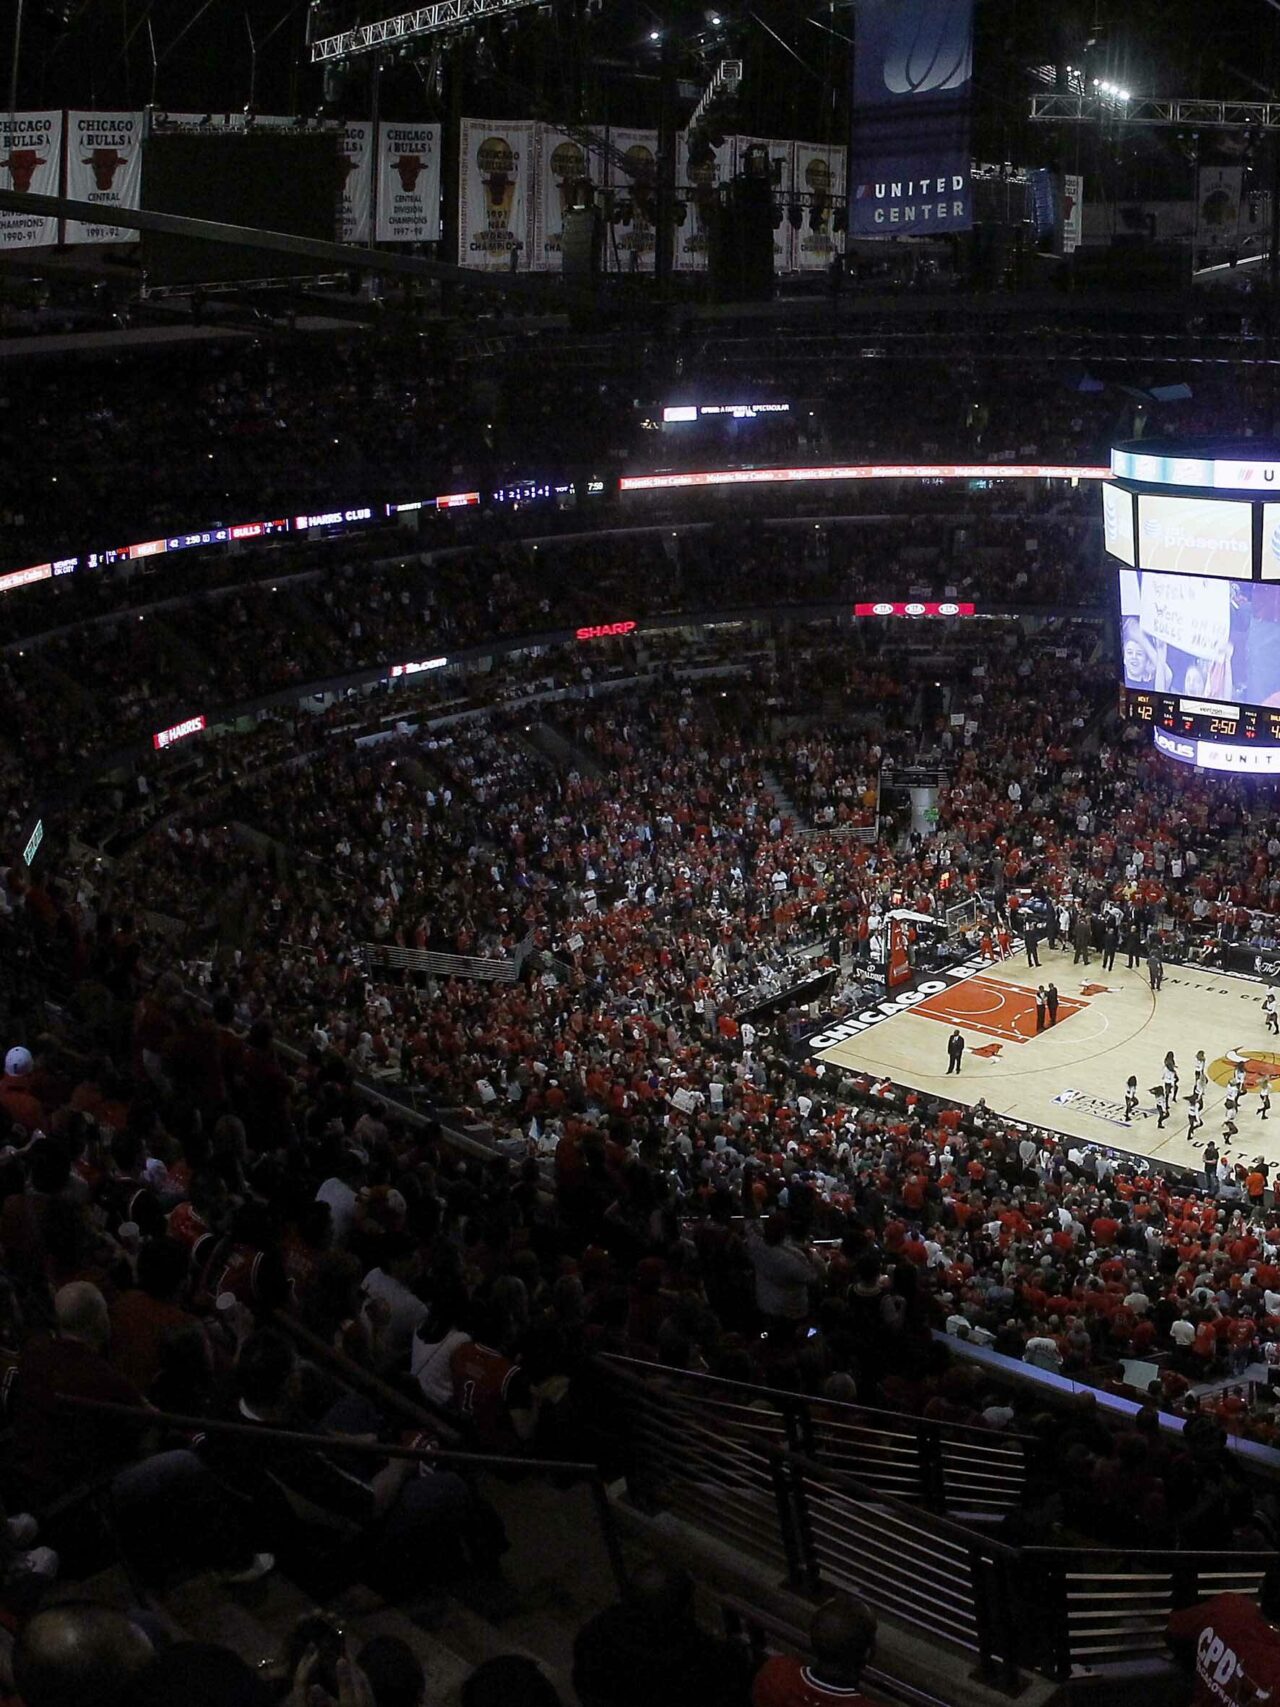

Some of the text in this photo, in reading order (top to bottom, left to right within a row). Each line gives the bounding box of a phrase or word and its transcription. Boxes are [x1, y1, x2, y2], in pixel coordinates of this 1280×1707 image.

[78, 120, 133, 132] CHICAGO
[3, 135, 44, 148] BULLS
[87, 135, 127, 146] BULLS
[387, 130, 433, 141] CHICAGO
[394, 143, 426, 153] BULLS
[875, 175, 964, 199] UNITED
[88, 193, 120, 201] CENTRAL
[874, 201, 964, 224] CENTER
[389, 217, 427, 225] CHAMPIONS
[4, 231, 36, 241] 1990-91
[87, 228, 119, 237] 1991-92
[394, 228, 422, 236] 1997-98
[588, 482, 603, 491] 7:59
[308, 508, 371, 527] HARRIS CLUB
[216, 530, 226, 540] 42
[234, 526, 261, 537] BULLS
[1164, 534, 1250, 553] presents
[576, 621, 636, 639] SHARP
[1137, 706, 1153, 720] 42
[1200, 707, 1223, 716] verizon
[169, 717, 202, 742] HARRIS
[1184, 721, 1190, 730] 2
[1210, 718, 1237, 735] 2:50
[1261, 961, 1276, 973] The
[856, 967, 885, 984] SPALDING
[809, 980, 947, 1048] CHICAGO
[1192, 1141, 1280, 1168] UITD
[1197, 1626, 1237, 1686] CPD
